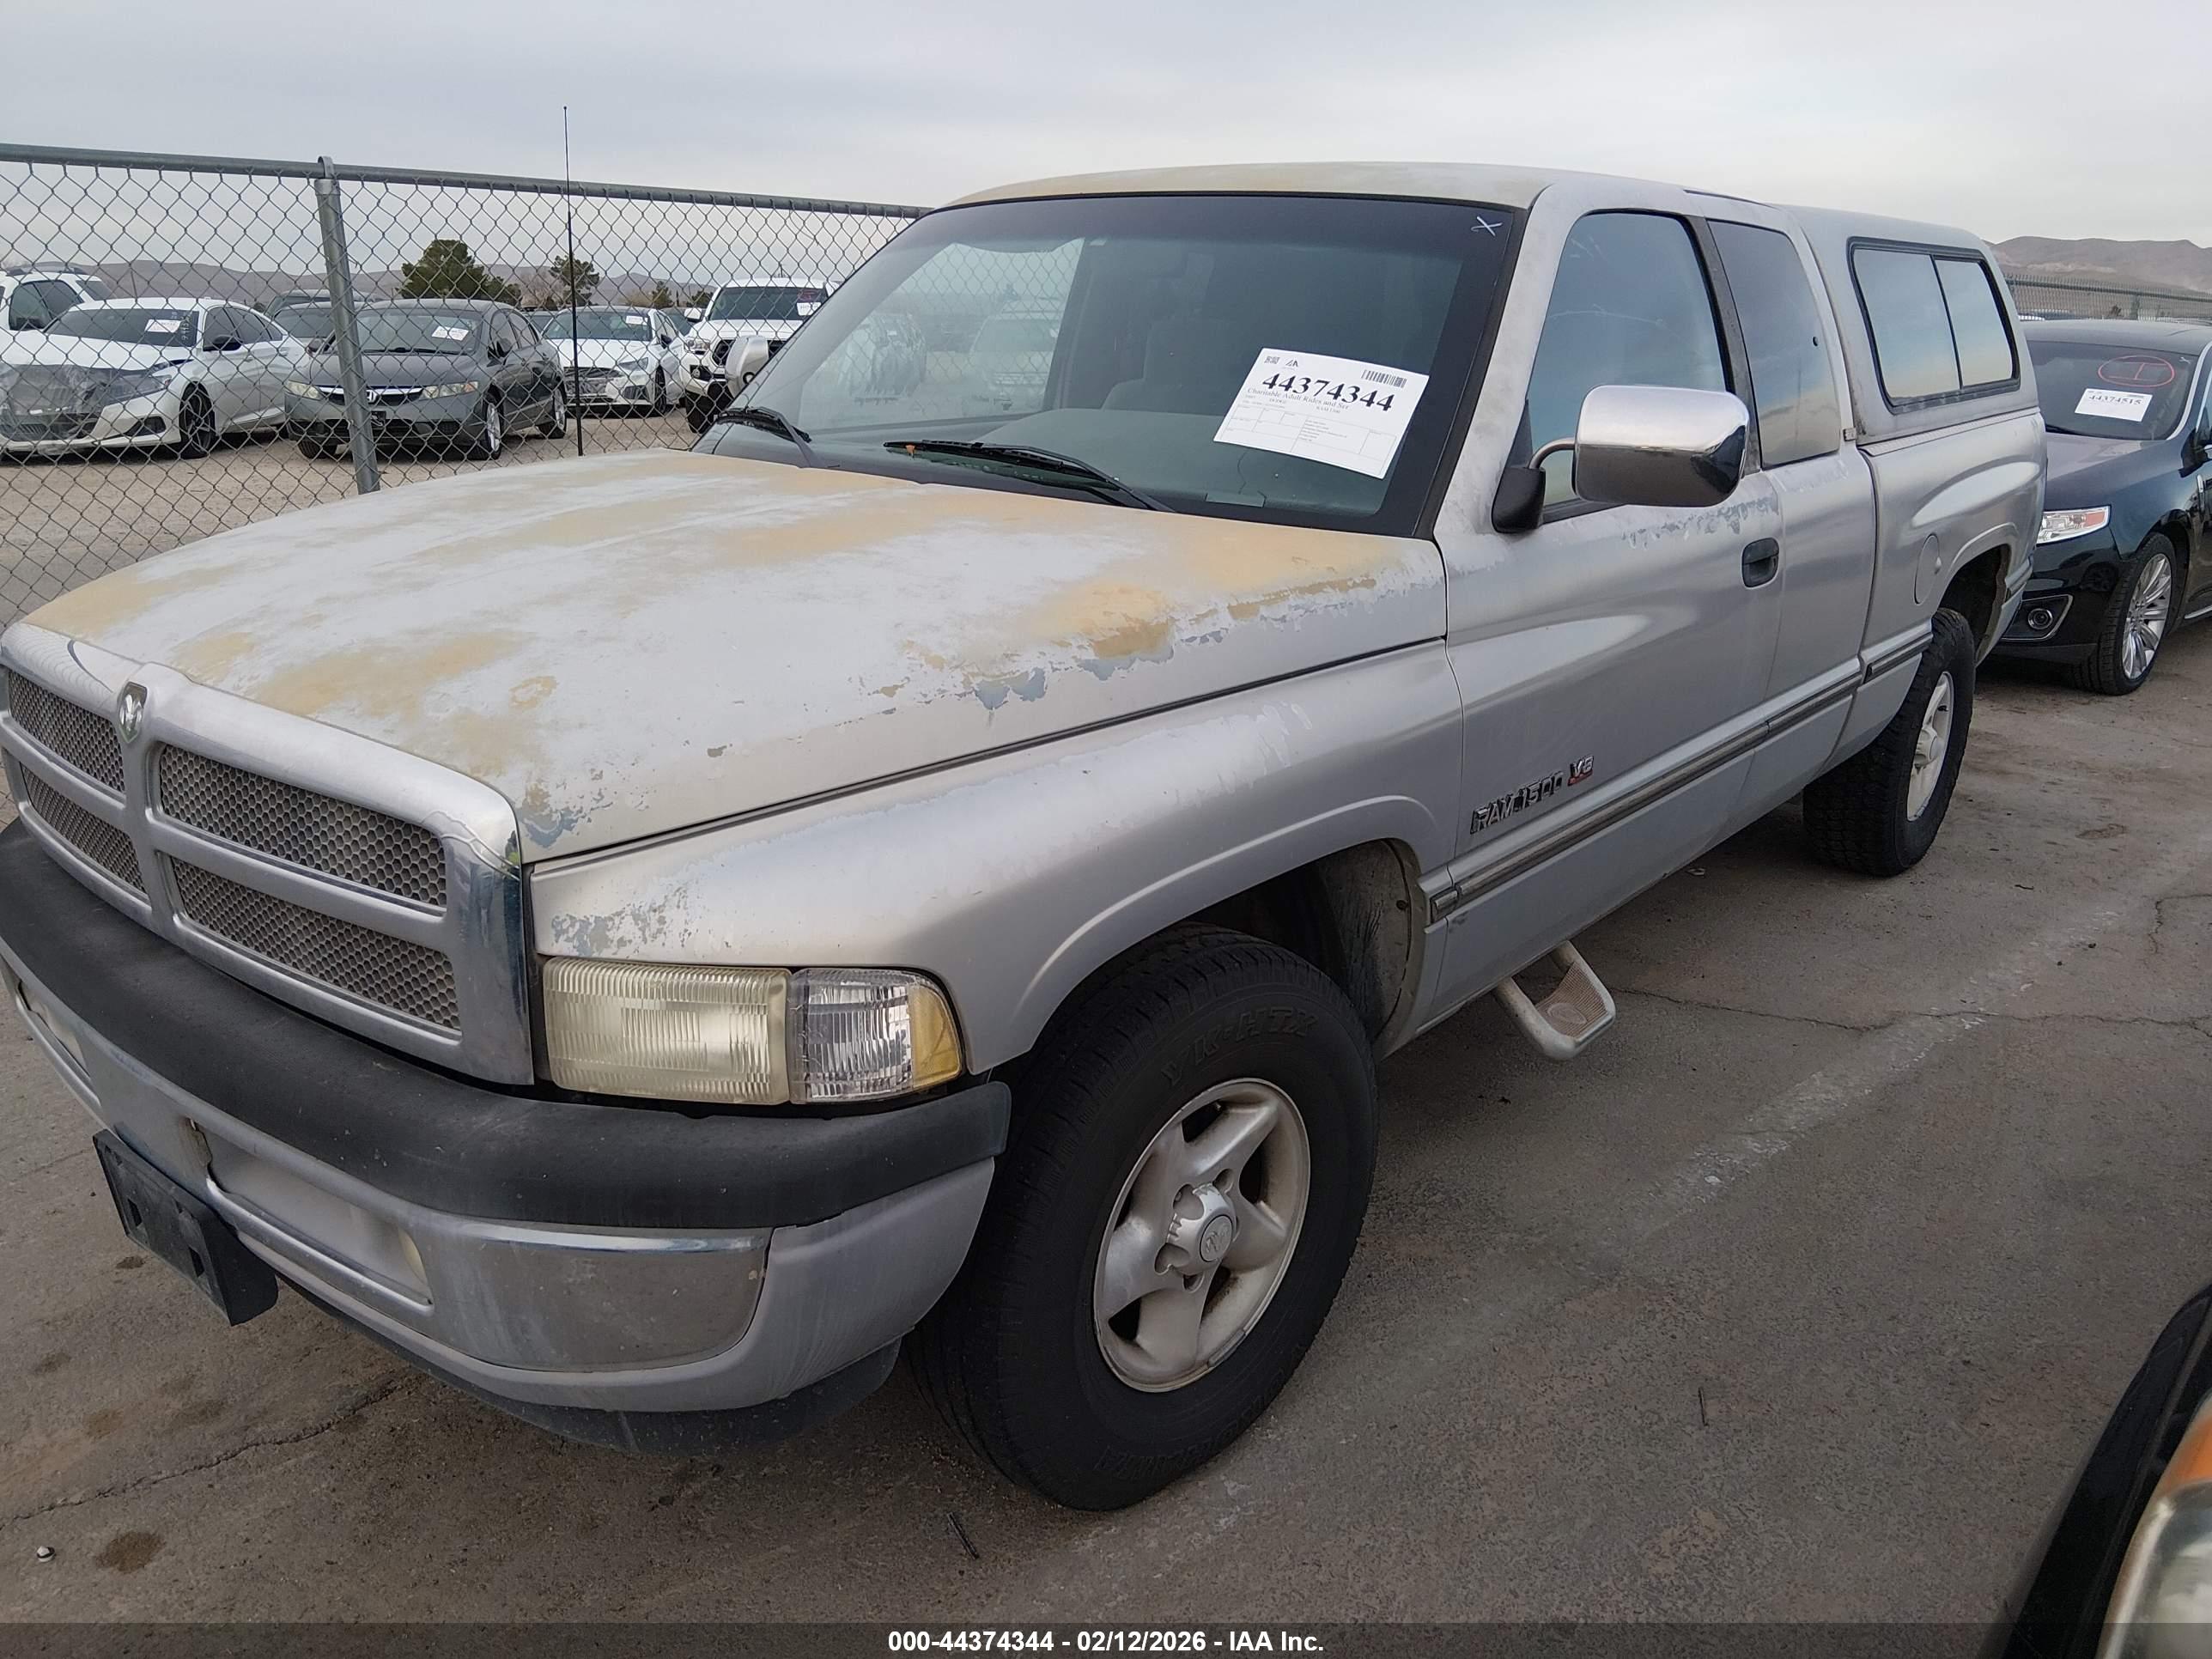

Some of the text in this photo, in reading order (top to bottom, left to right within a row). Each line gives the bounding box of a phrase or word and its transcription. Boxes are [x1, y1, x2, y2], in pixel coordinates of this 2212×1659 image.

[1248, 387, 1281, 398] Charitable
[1283, 392, 1302, 401] Adult
[1302, 395, 1322, 404] Rides
[1322, 398, 1336, 407] and
[1262, 373, 1395, 411] 44374344
[1470, 755, 1595, 835] RAM 1500 V8
